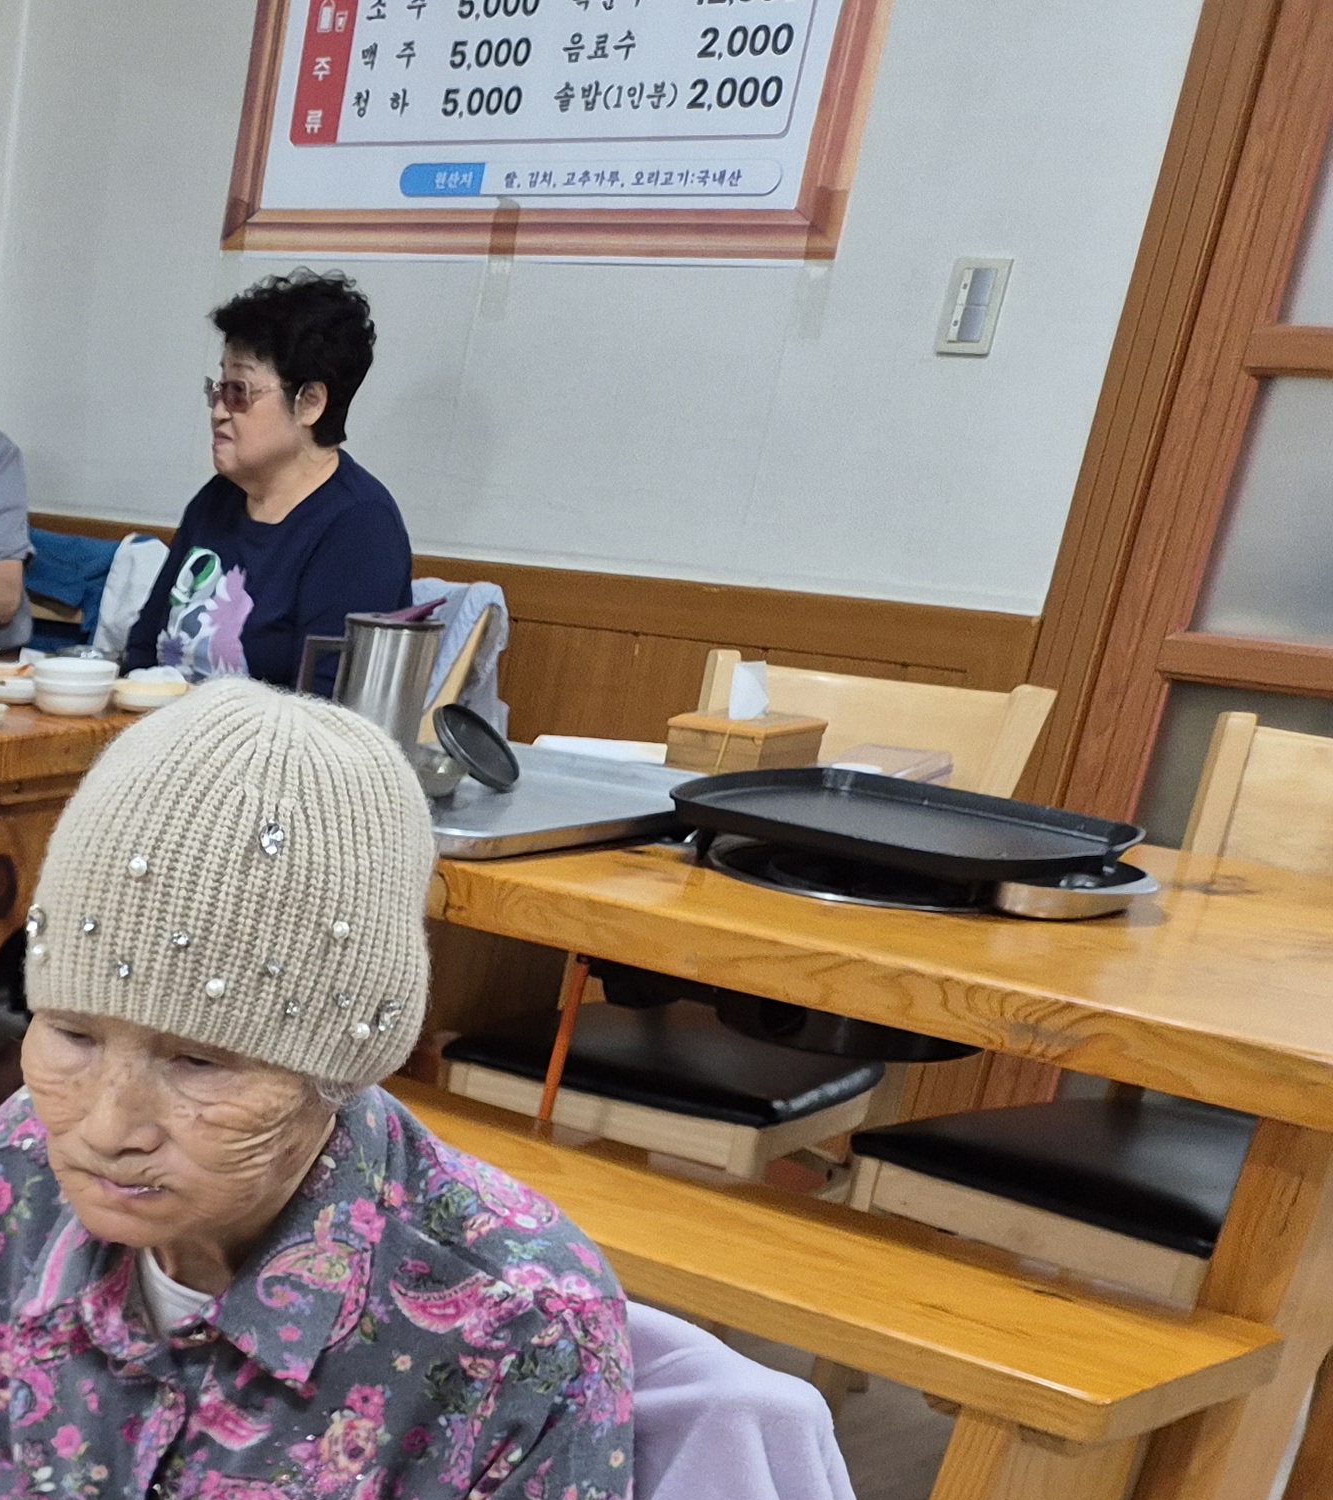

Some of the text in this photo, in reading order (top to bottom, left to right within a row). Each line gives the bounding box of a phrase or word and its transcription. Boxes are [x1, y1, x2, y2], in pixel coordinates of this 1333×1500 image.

[449, 37, 532, 71] 5,000
[562, 29, 636, 63] 음료수
[696, 23, 794, 60] 2,000
[441, 85, 523, 118] 5,000
[553, 80, 678, 113] 솔밥(1인분)
[686, 75, 783, 112] 2,000
[434, 171, 474, 190] 원산지
[528, 170, 556, 189] 김치,
